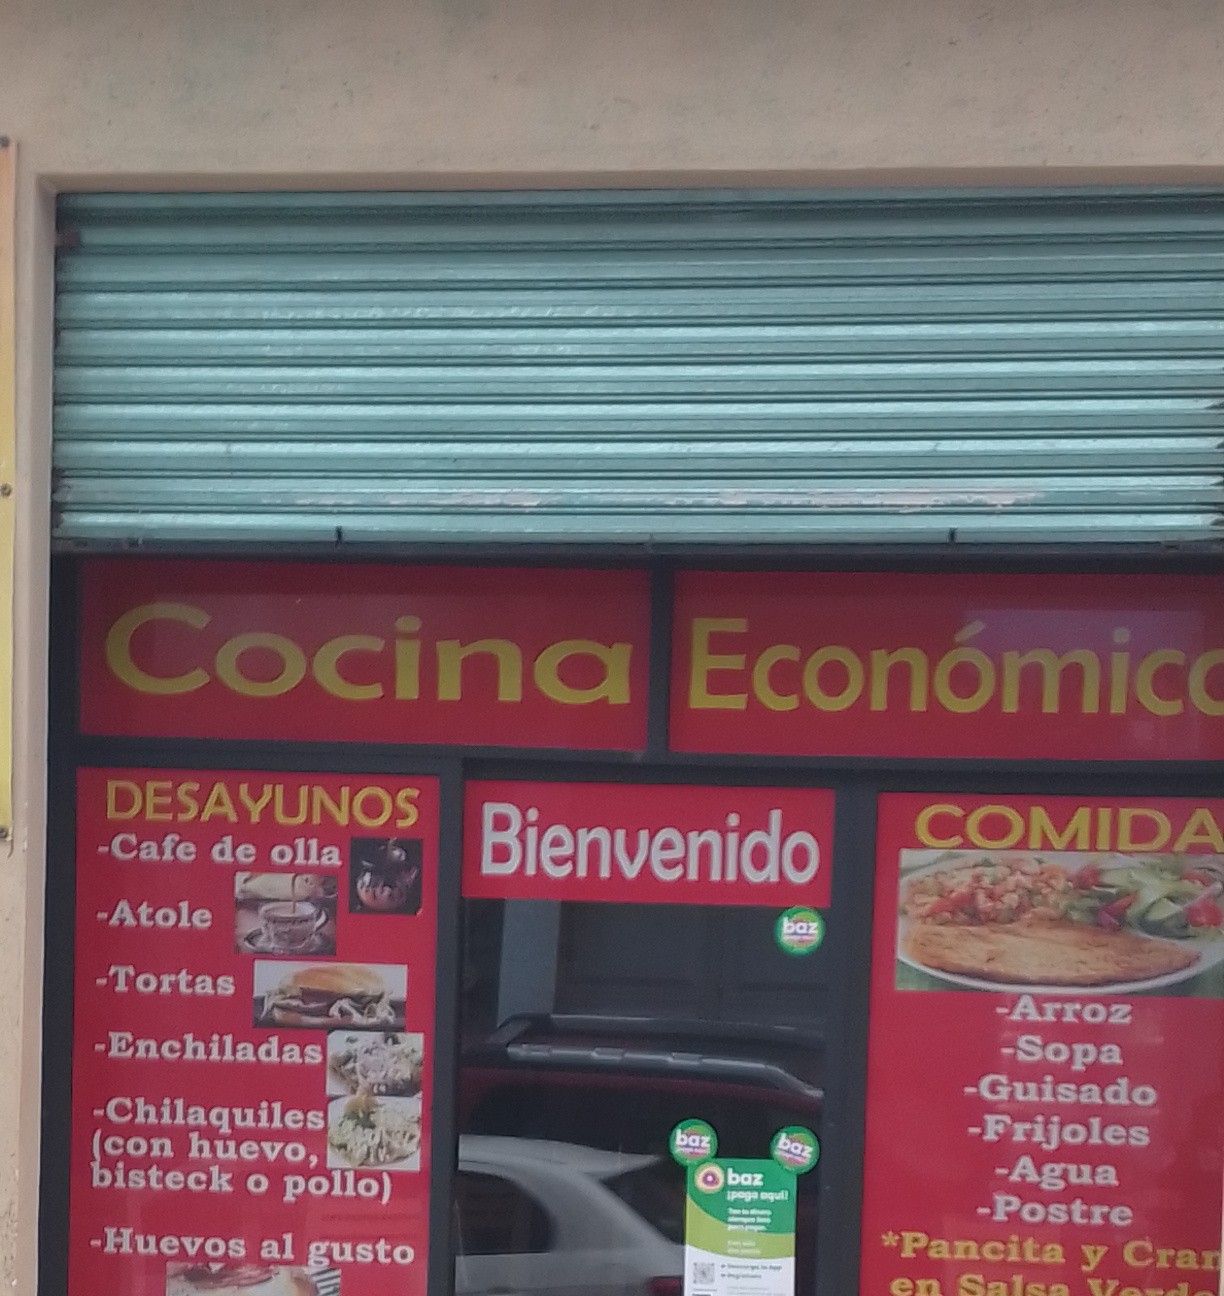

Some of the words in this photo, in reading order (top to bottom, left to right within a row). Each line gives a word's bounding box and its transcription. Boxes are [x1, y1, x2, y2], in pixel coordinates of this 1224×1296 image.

[105, 601, 633, 705] Cocina
[106, 780, 420, 829] DESAYUNOS
[481, 801, 820, 885] Bienvenido
[915, 804, 1224, 853] COMIDA
[97, 834, 197, 862] -Cafe
[212, 836, 256, 865] de
[270, 838, 342, 867] olla
[97, 900, 213, 929] -Atole
[783, 916, 818, 934] baz
[96, 964, 236, 996] -Tortas
[996, 994, 1131, 1024] -Arroz
[94, 1031, 323, 1066] -Enchiladas
[1001, 1035, 1123, 1071] -Sopa
[963, 1073, 1158, 1107] -Guisado
[93, 1096, 325, 1134] -Chilaquiles
[967, 1114, 1150, 1151] -Frijoles
[91, 1129, 174, 1162] (con
[188, 1132, 319, 1168] huevo,
[675, 1128, 711, 1148] baz
[778, 1133, 813, 1159] baz
[91, 1161, 232, 1193] bisteck
[246, 1172, 269, 1194] o
[283, 1169, 392, 1205] pollo)
[727, 1168, 764, 1186] baz
[994, 1155, 1119, 1191] -Agua
[976, 1192, 1133, 1227] -Postre
[90, 1227, 246, 1259] -Huevos
[261, 1234, 294, 1259] al
[307, 1239, 415, 1267] gusto
[1081, 1244, 1109, 1272] y
